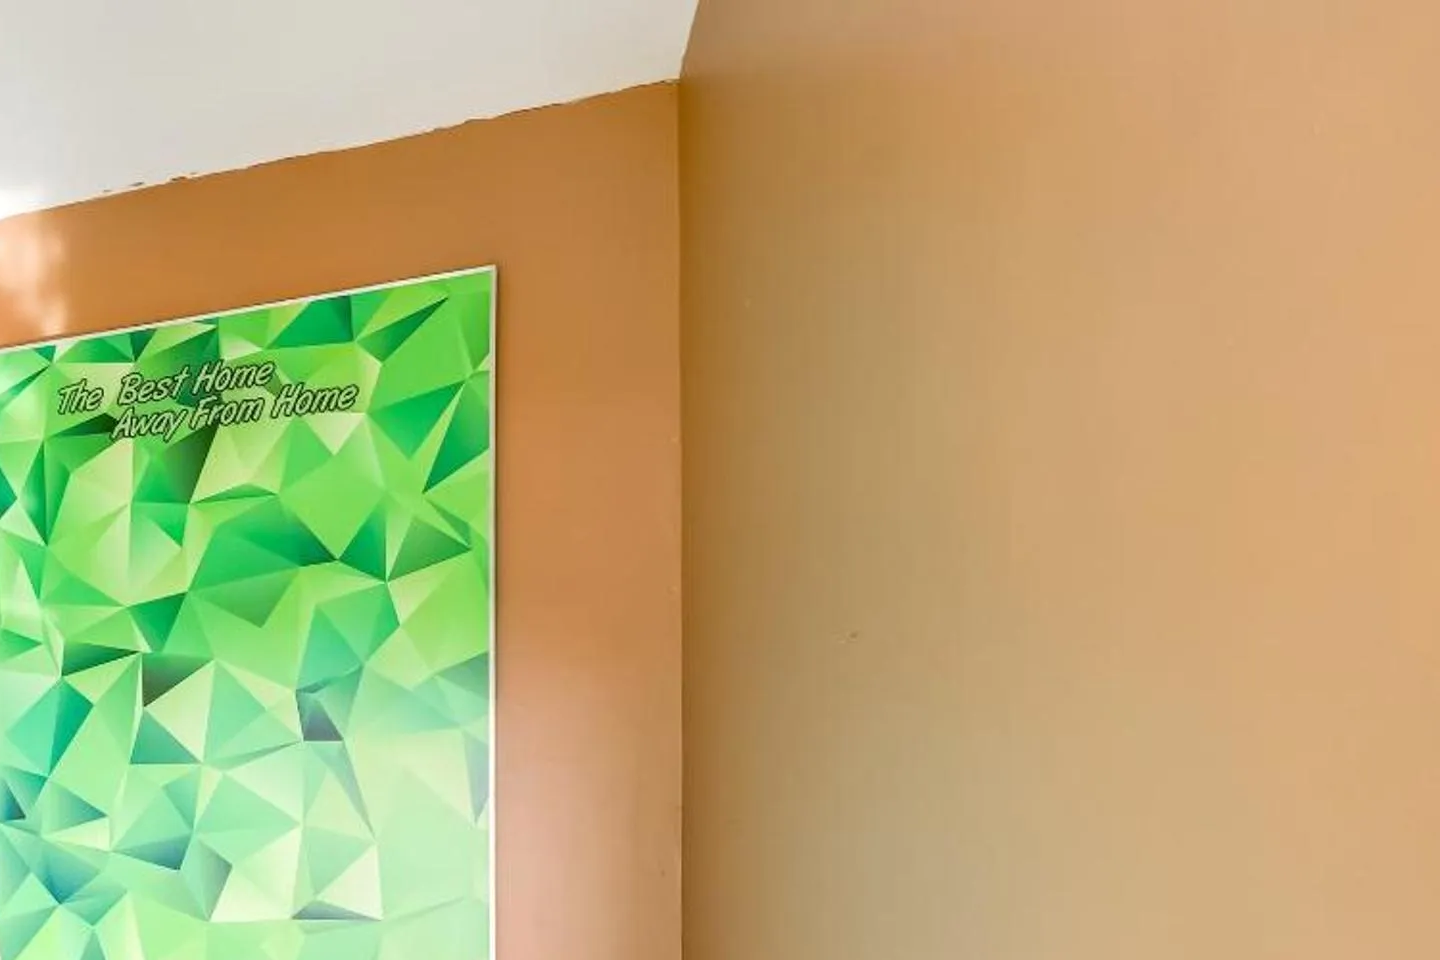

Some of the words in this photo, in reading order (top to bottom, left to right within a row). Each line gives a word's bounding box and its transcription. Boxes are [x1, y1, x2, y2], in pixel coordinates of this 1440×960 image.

[58, 378, 105, 415] The
[117, 366, 191, 406] Best
[193, 359, 275, 397] Home
[110, 406, 188, 443] Away
[189, 394, 266, 431] From
[271, 381, 360, 418] Home
